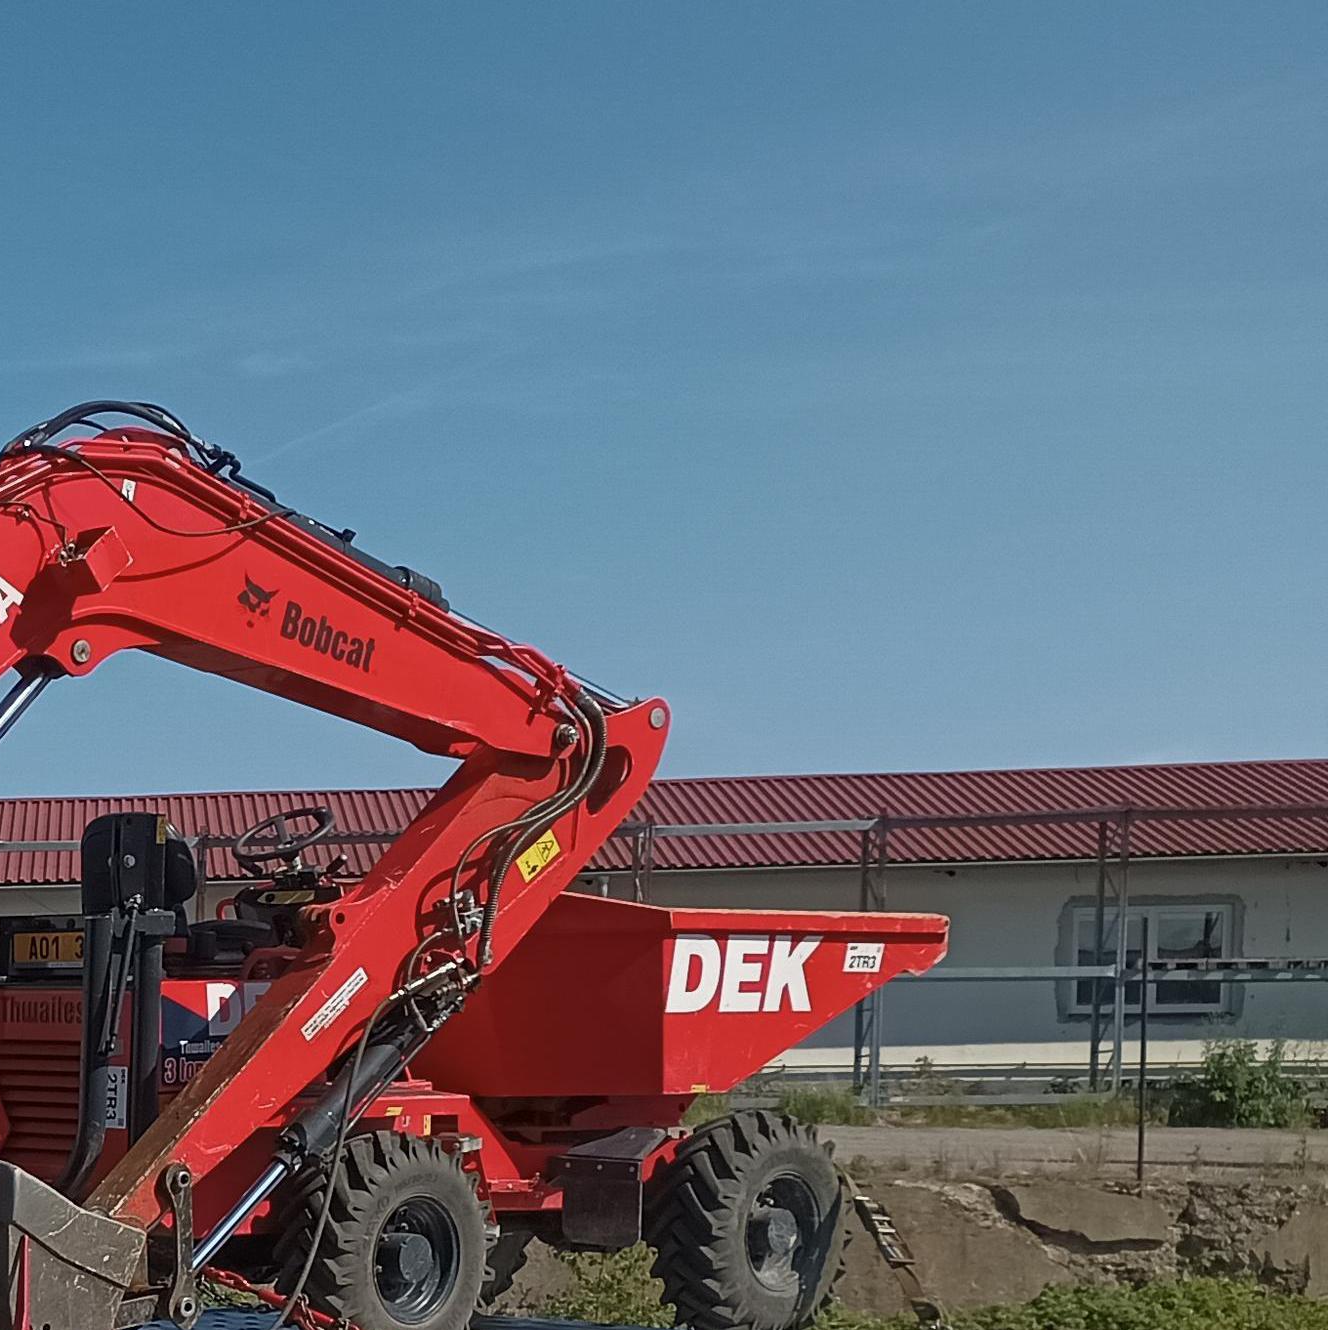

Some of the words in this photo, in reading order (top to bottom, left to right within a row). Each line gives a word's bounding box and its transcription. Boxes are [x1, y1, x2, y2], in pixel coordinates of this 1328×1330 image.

[280, 600, 376, 673] Bobcat
[28, 935, 60, 960] A01
[665, 934, 824, 1013] DEK
[164, 1057, 177, 1084] 3
[105, 1072, 119, 1120] 2TR3
